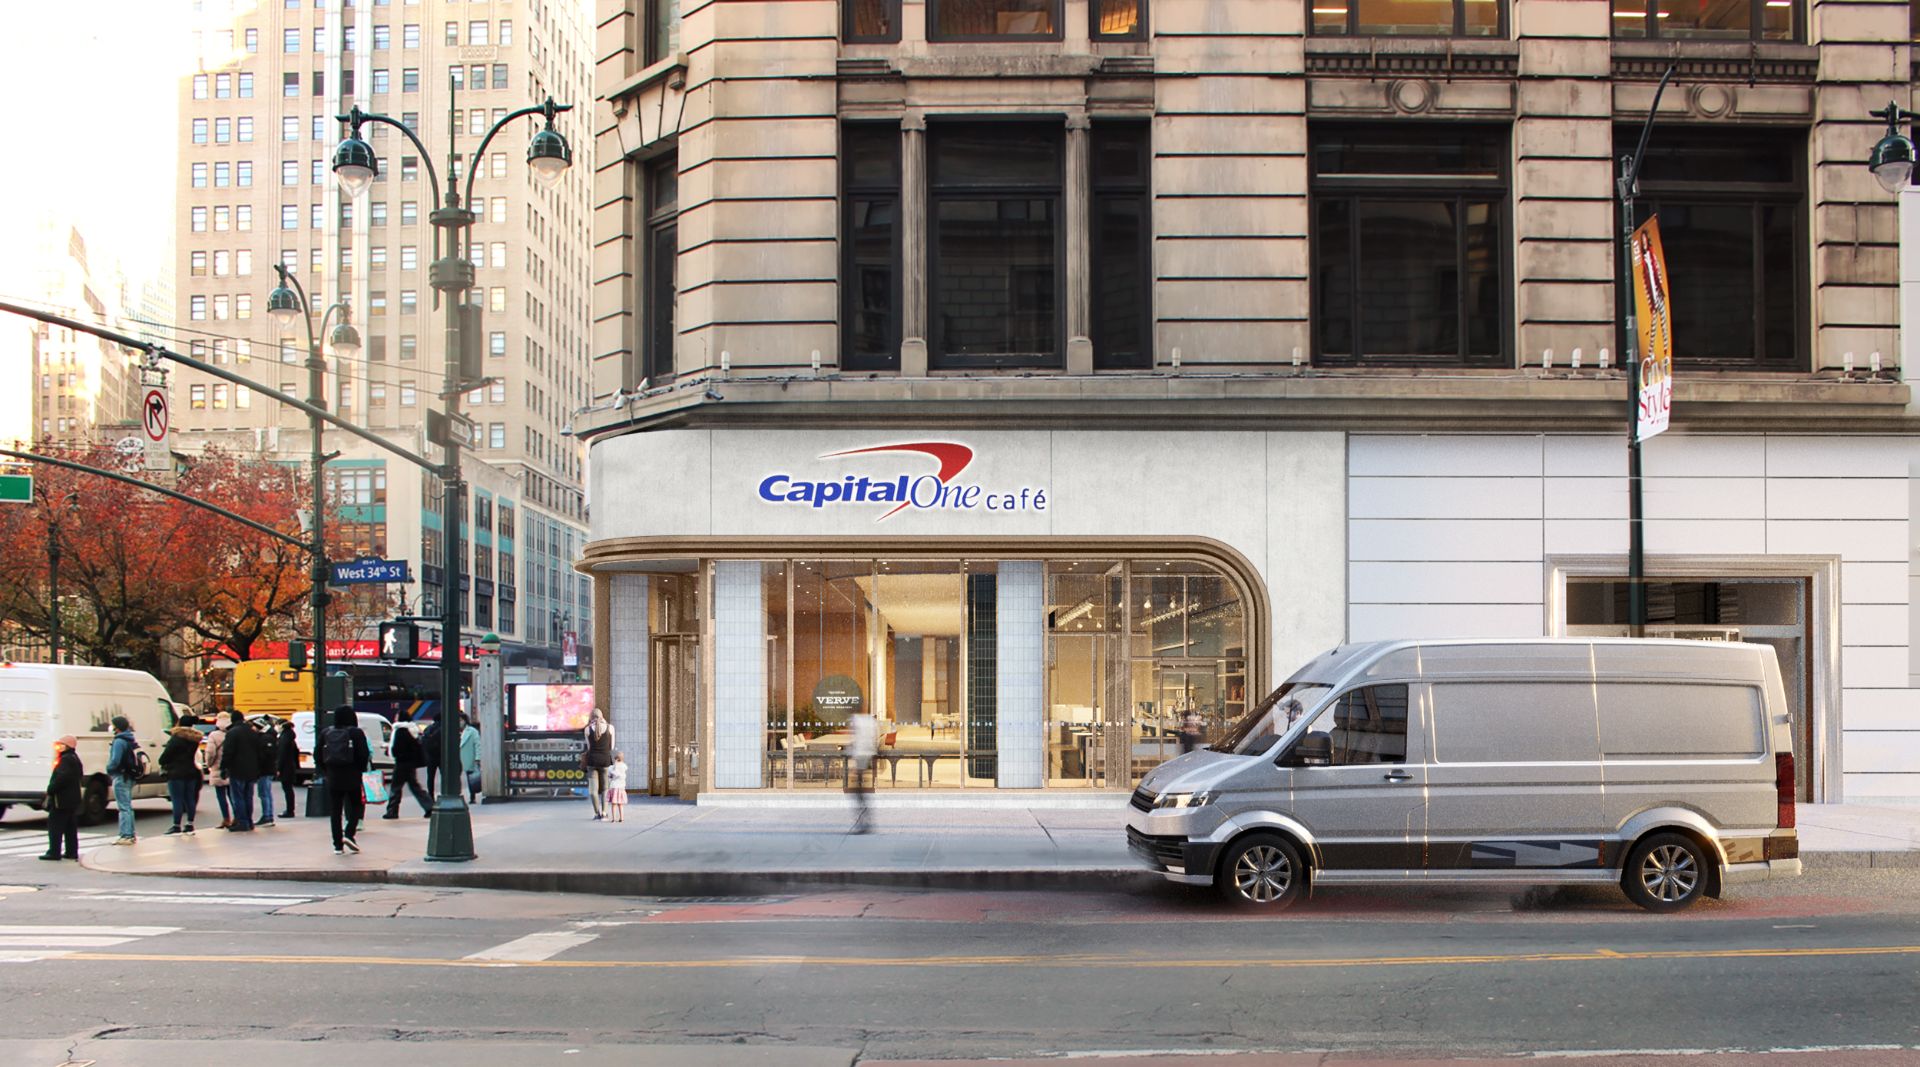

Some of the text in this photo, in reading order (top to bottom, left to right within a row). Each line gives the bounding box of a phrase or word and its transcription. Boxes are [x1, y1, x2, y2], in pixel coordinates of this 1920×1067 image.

[1638, 382, 1671, 424] Style
[986, 489, 1046, 509] café
[337, 566, 401, 579] West 34th St
[816, 696, 860, 704] VERVE
[521, 753, 572, 761] Street-Herald
